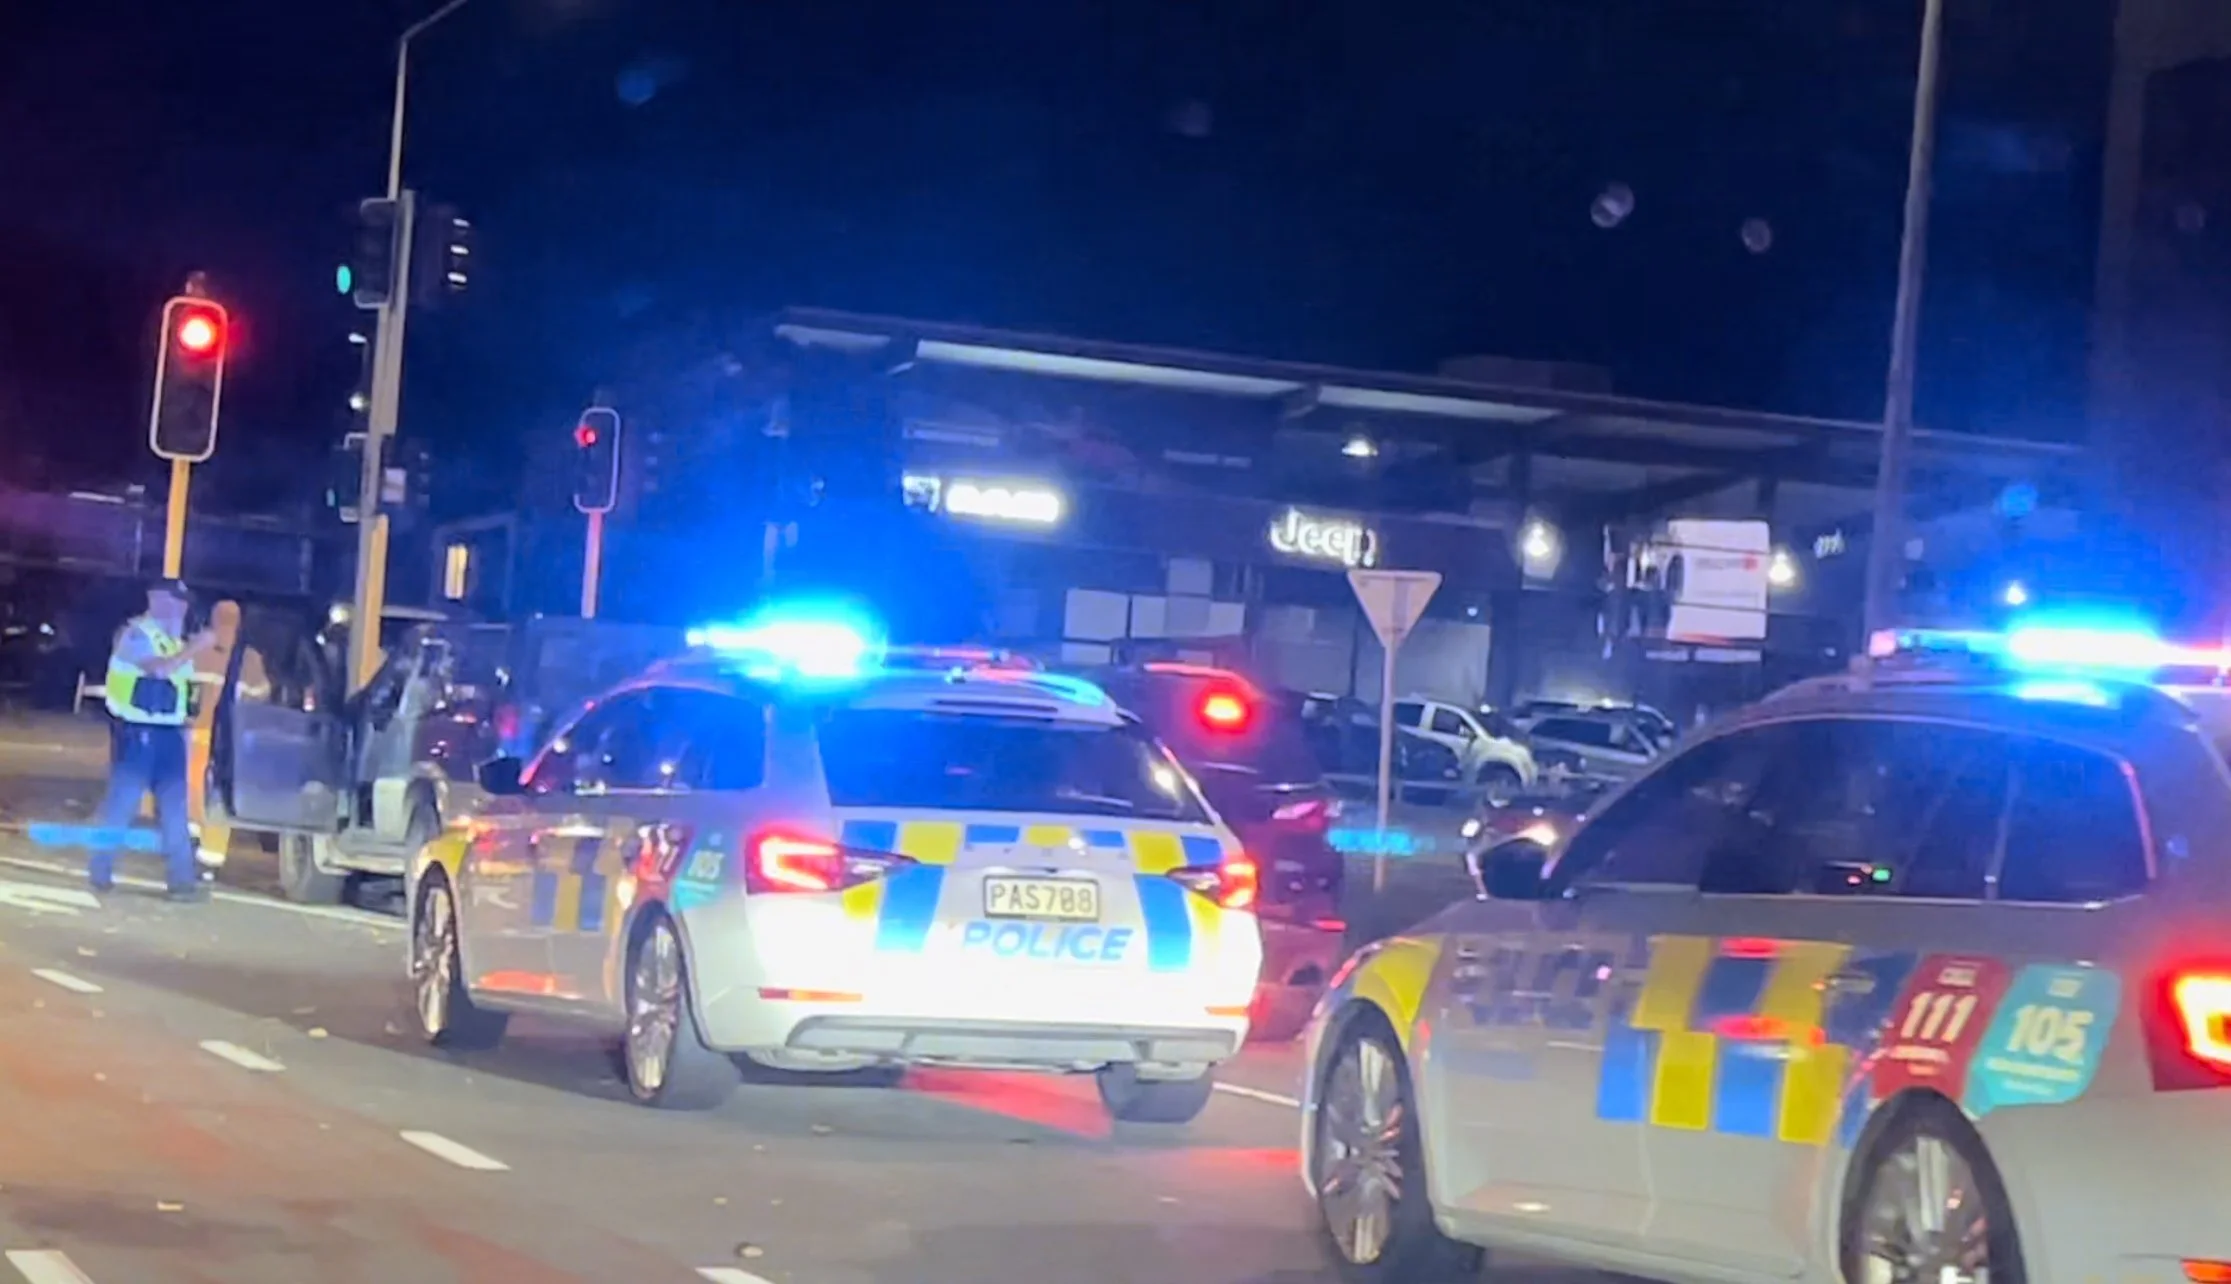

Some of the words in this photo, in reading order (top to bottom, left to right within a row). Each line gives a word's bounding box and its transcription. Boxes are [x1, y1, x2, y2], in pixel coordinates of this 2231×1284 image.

[1270, 505, 1377, 567] Jeep
[963, 921, 1134, 961] POLICE
[1900, 992, 1978, 1042] 111
[2006, 1004, 2094, 1065] 105
